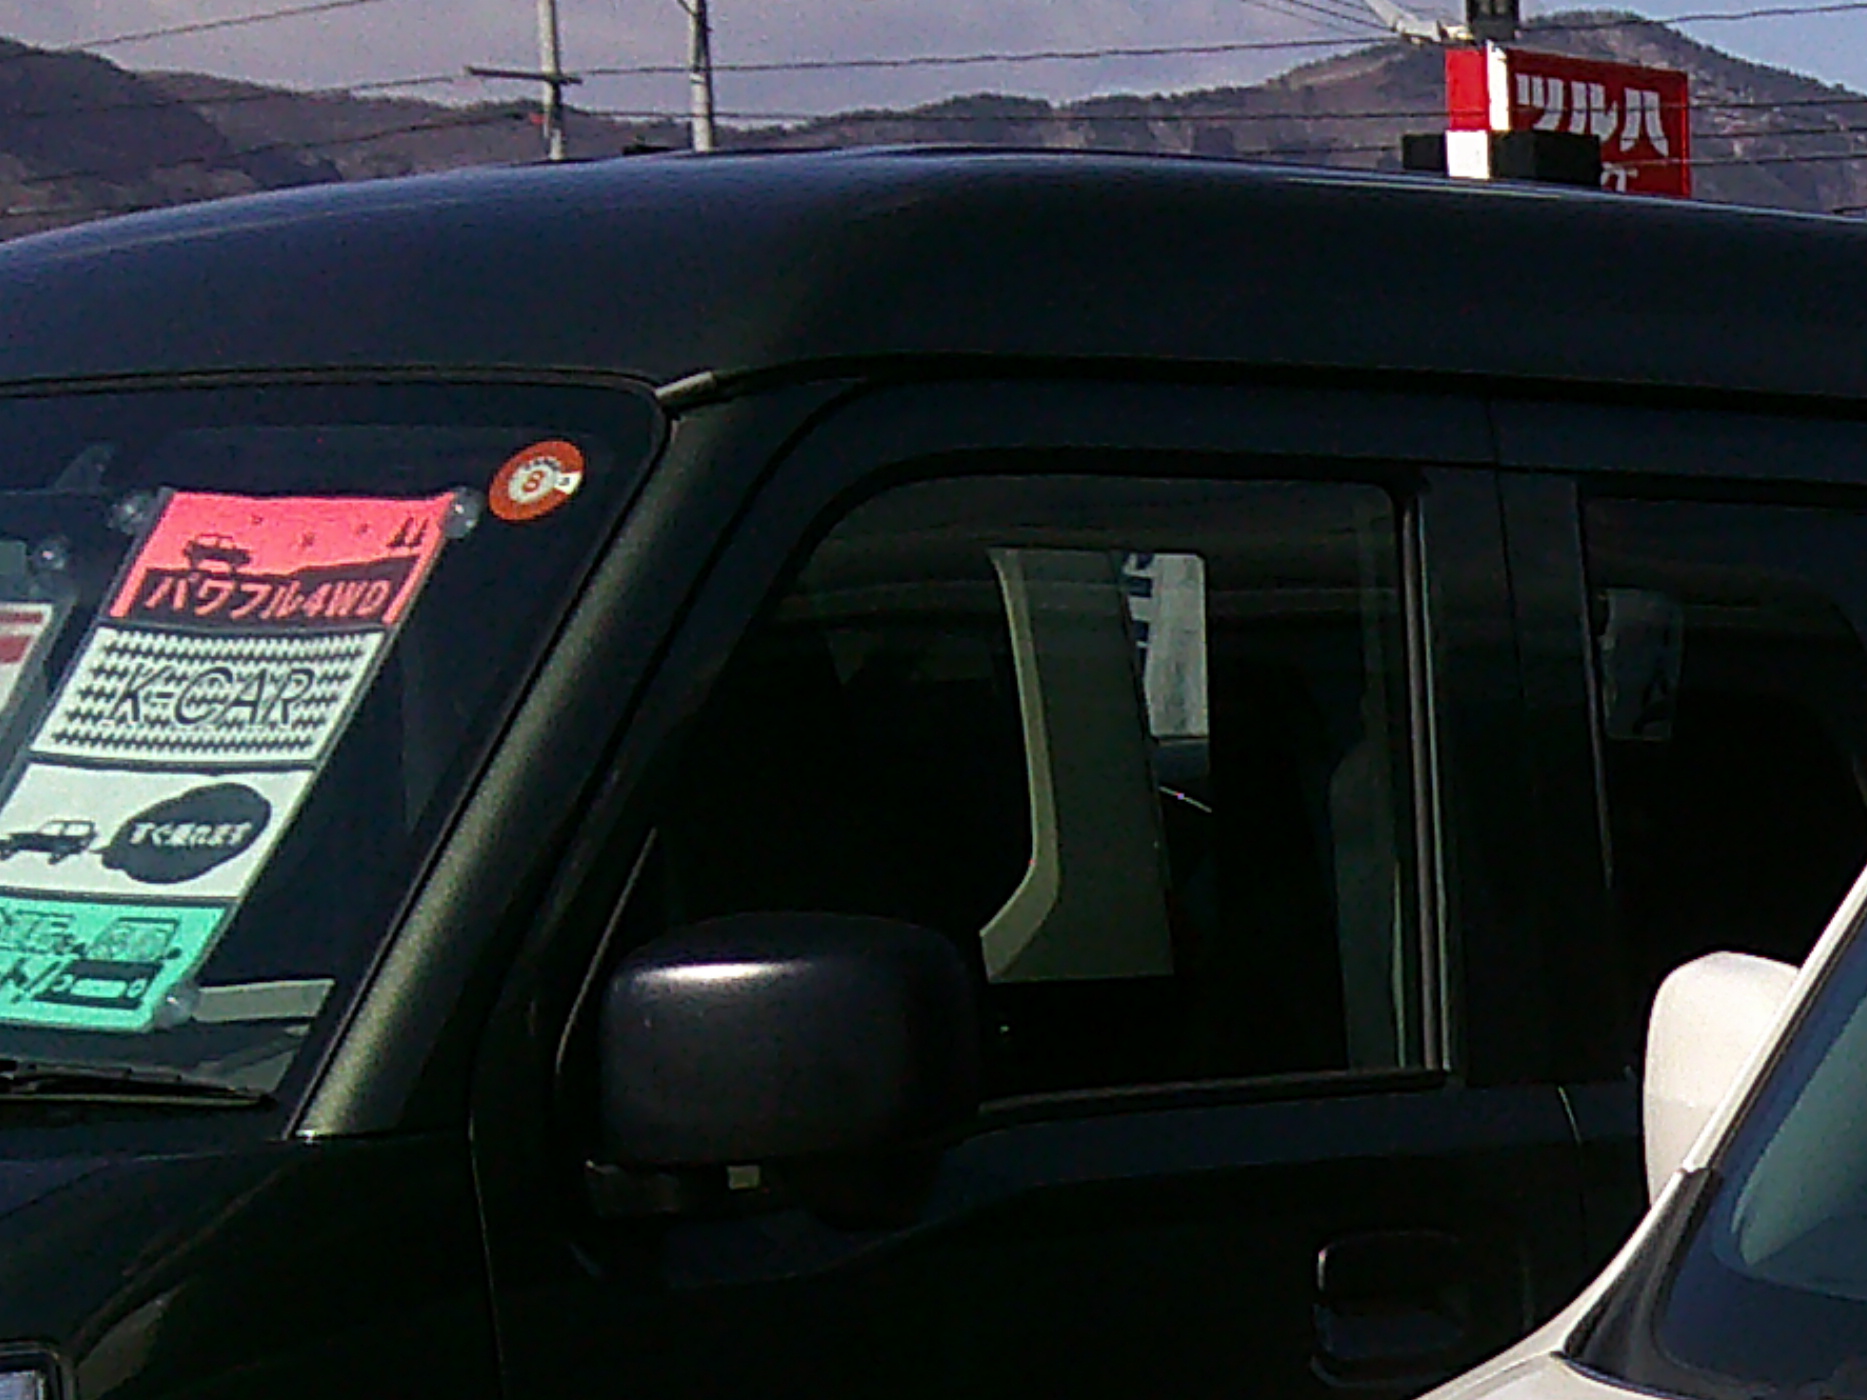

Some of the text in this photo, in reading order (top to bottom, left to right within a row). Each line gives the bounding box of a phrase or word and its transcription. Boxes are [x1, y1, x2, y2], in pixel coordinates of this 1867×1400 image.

[1515, 73, 1669, 157] ツルハ
[144, 575, 392, 620] パワフル4WD
[108, 663, 315, 728] K-CAR
